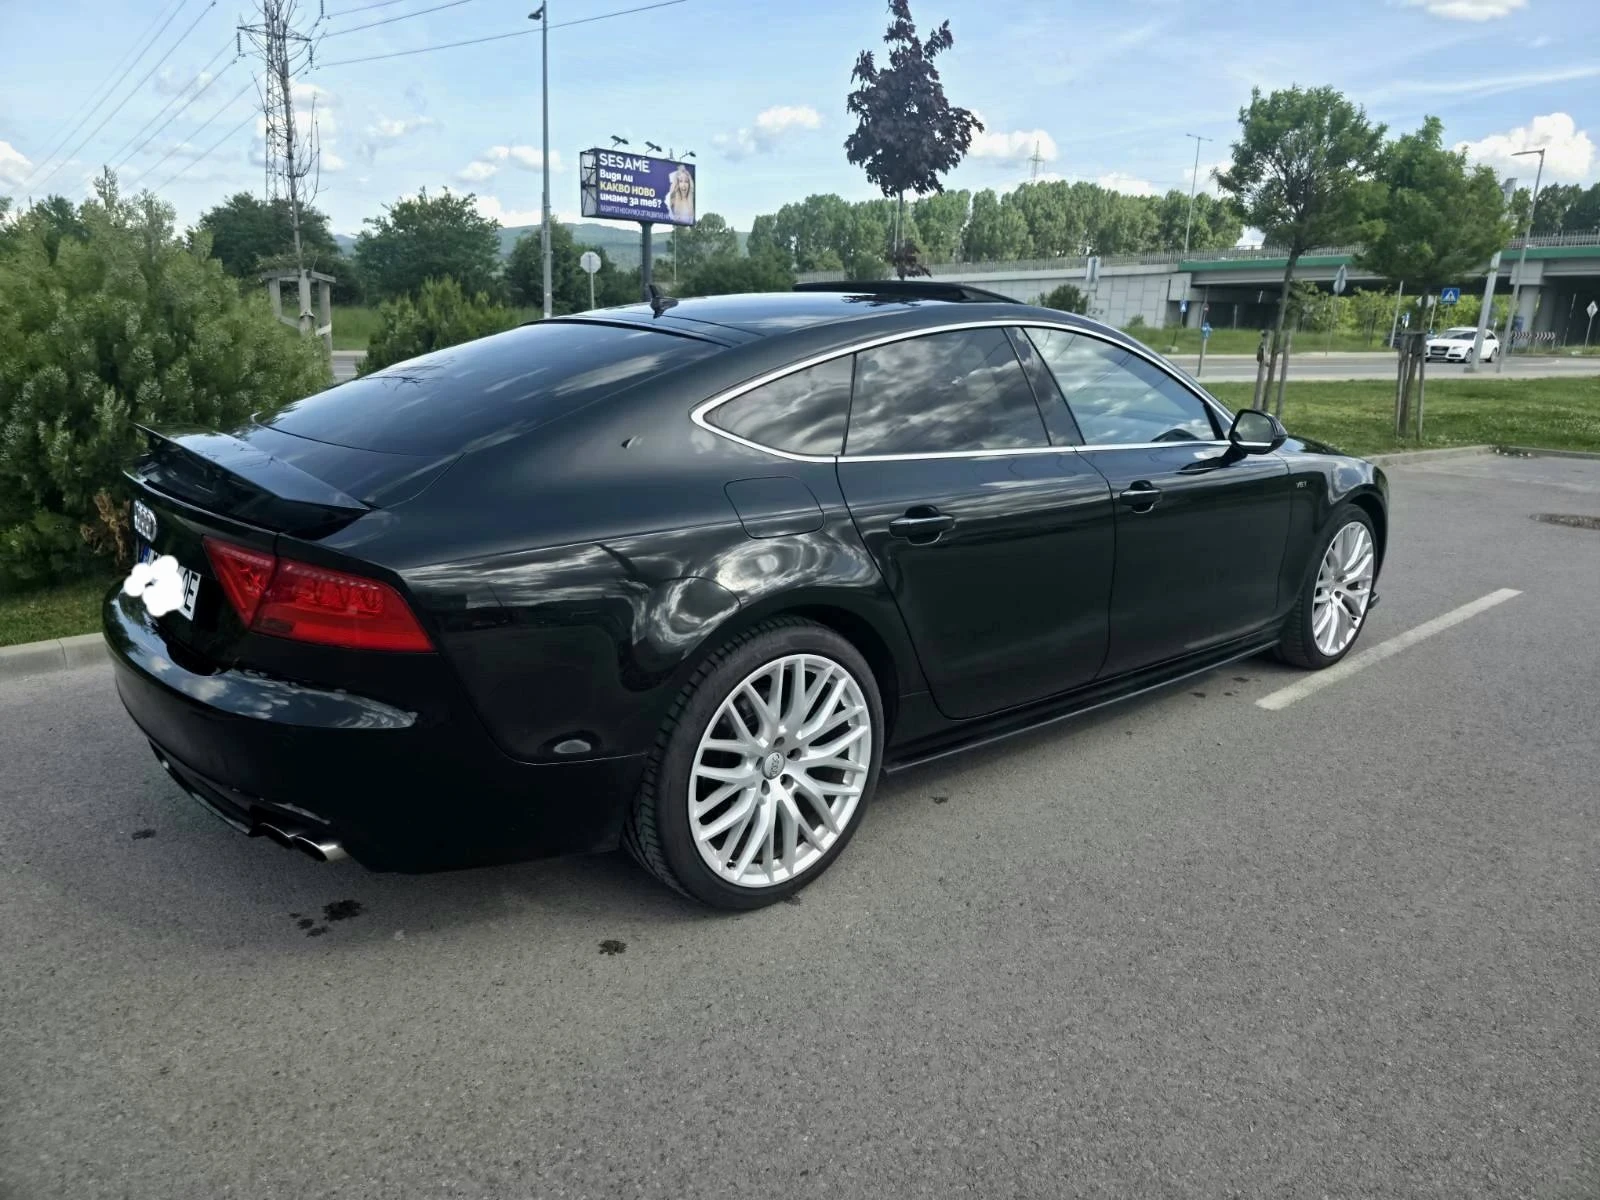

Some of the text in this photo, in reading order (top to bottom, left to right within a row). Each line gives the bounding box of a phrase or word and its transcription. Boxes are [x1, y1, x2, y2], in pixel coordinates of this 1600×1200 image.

[599, 153, 650, 173] SESAME
[600, 169, 633, 182] Видя ли
[600, 181, 655, 197] КАКВО НОВО
[600, 193, 662, 208] имаме за теб?
